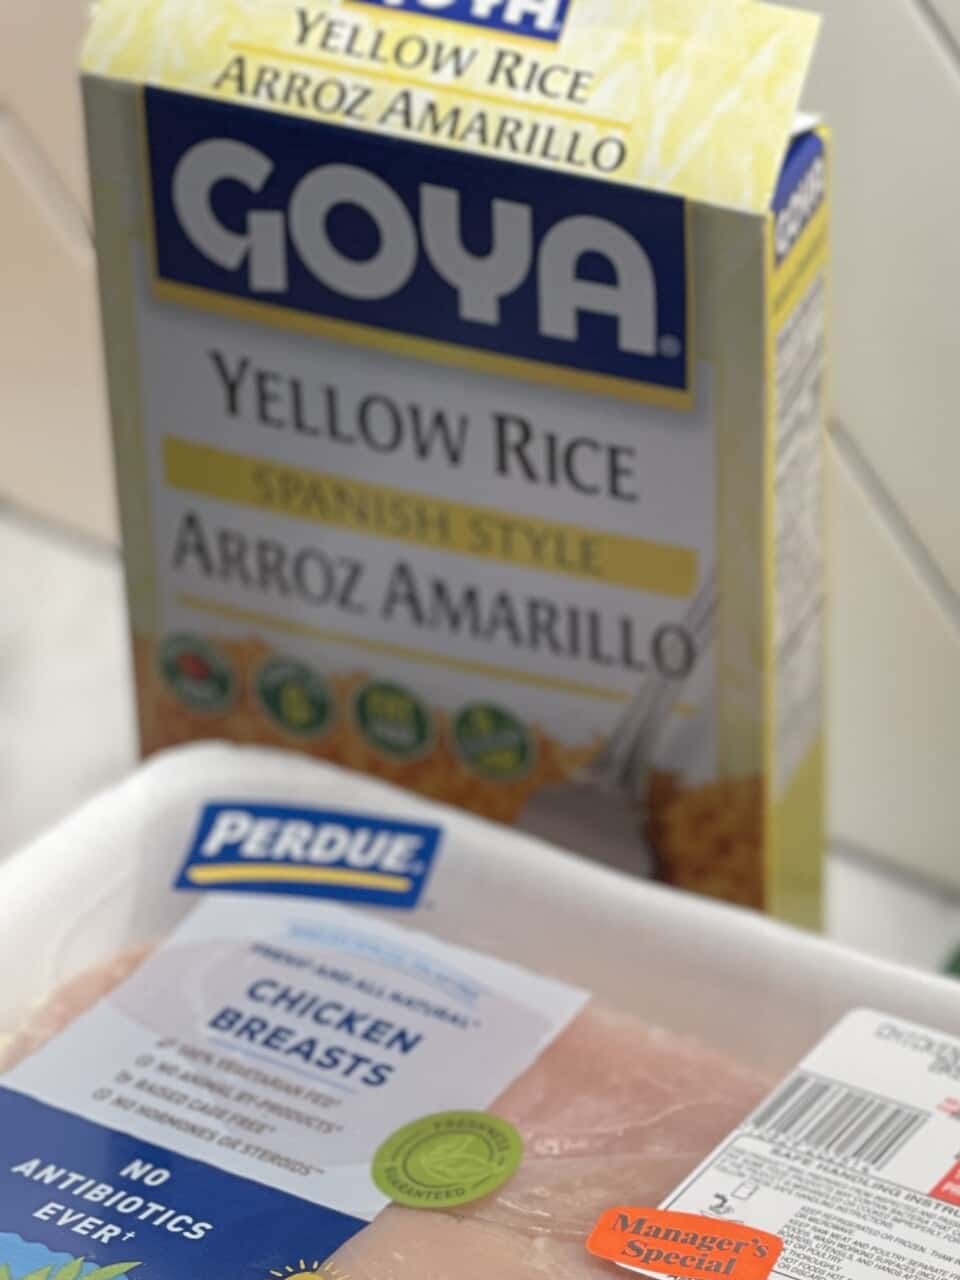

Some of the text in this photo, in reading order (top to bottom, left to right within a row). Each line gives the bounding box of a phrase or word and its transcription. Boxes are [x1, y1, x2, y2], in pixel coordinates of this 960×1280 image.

[294, 9, 477, 78] YELLOW
[487, 49, 594, 105] RICE
[213, 55, 628, 174] ARROZ AMARILLO
[172, 137, 660, 358] GOYA
[208, 348, 639, 505] YELLOW RICE
[253, 462, 604, 578] SPANISH STYLE
[171, 510, 698, 683] ARROZ AMARILLO
[201, 810, 424, 873] PERDUE
[210, 1008, 391, 1086] BREASTS
[247, 979, 421, 1053] CHICKEN
[10, 1157, 213, 1240] ANTIBIOTICS
[119, 1158, 171, 1186] NO
[816, 1163, 901, 1197] HANDLING
[612, 1213, 769, 1258] Manager's
[623, 1239, 737, 1275] Special
[836, 1242, 874, 1259] WORKING
[874, 1255, 915, 1274] SURFACES
[851, 1239, 869, 1249] AND
[869, 1245, 906, 1261] POULTRY
[907, 1259, 947, 1276] SEPARATE
[855, 1256, 874, 1266] AND
[873, 1263, 902, 1276] HANDS
